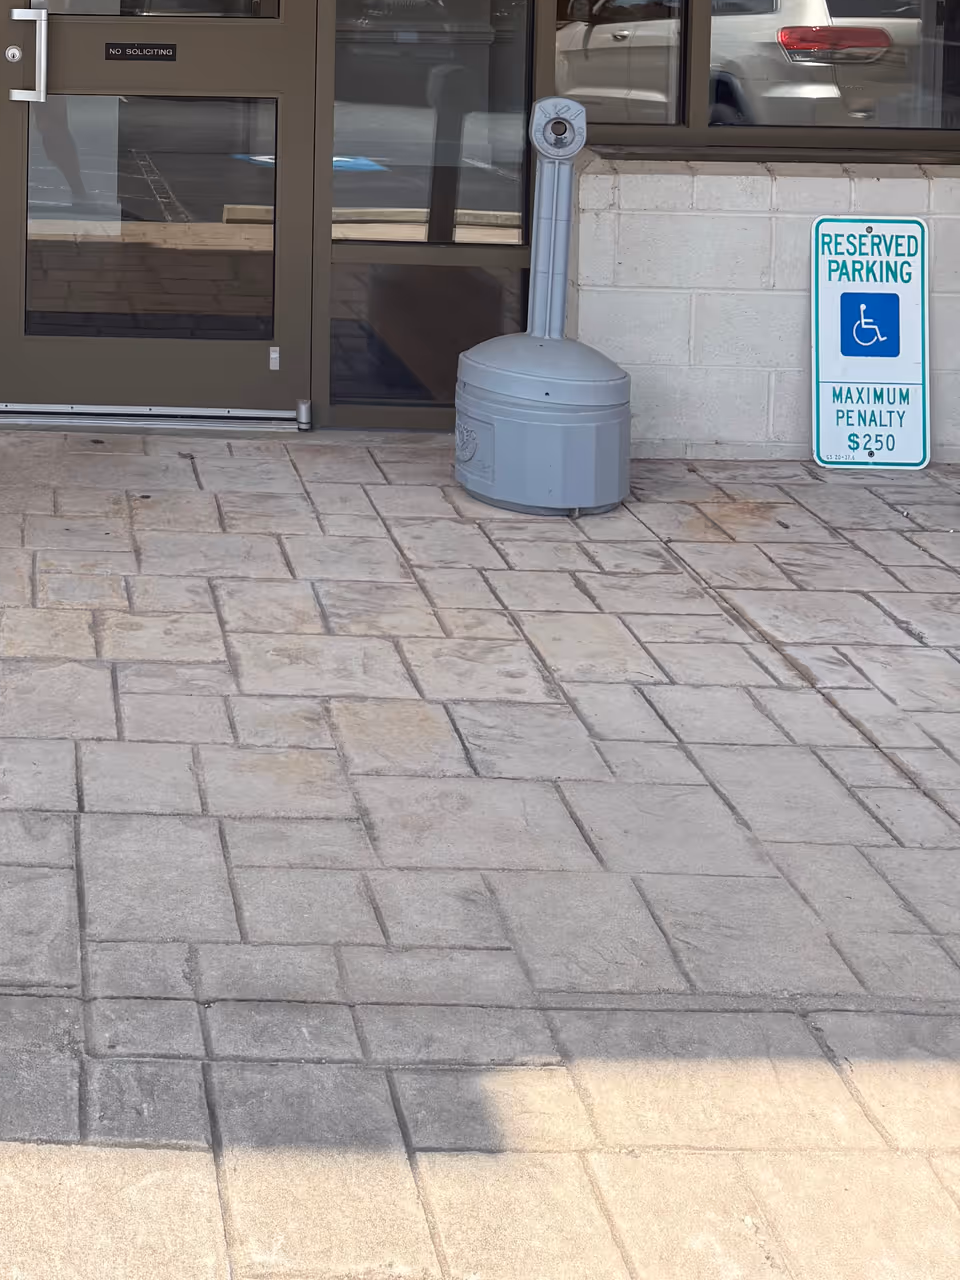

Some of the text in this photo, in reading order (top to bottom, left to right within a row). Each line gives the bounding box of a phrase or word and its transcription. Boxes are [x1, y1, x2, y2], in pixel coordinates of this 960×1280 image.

[126, 48, 173, 56] SOLICITING
[821, 233, 918, 257] RESERVED
[827, 260, 913, 284] PARKING
[832, 387, 910, 405] MAXIMUM
[836, 410, 906, 427] PENALTY
[847, 432, 896, 452] $250
